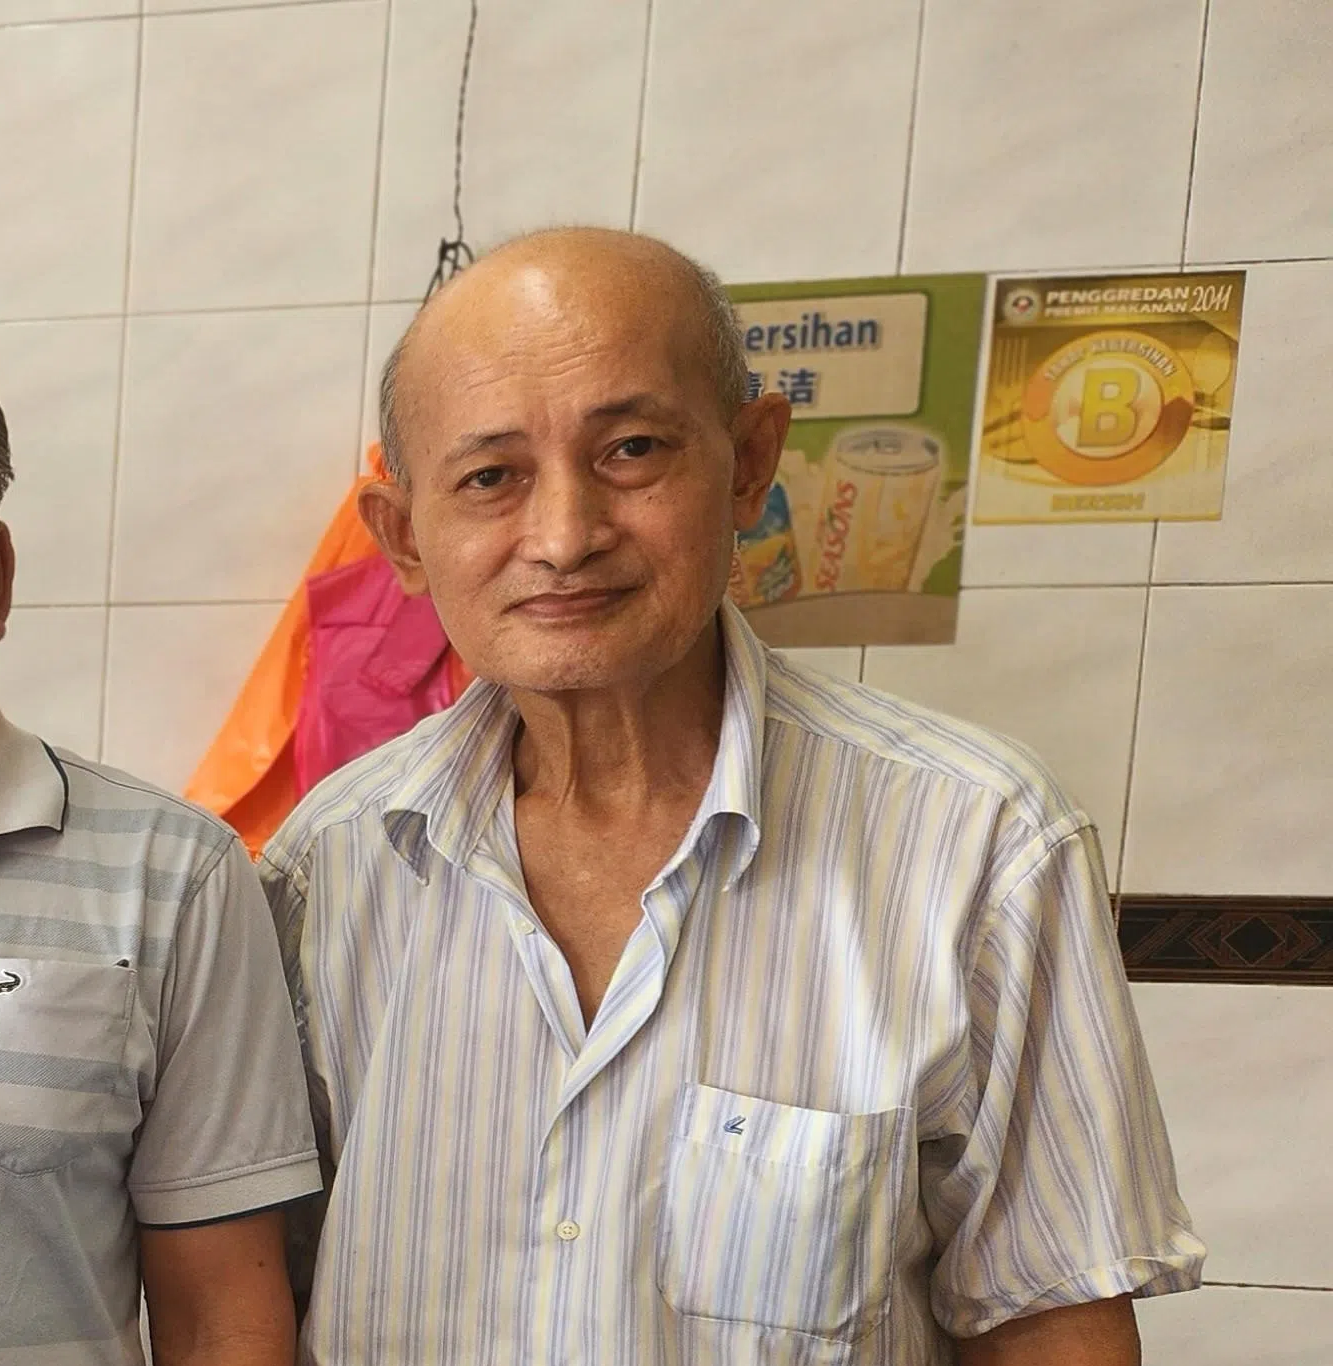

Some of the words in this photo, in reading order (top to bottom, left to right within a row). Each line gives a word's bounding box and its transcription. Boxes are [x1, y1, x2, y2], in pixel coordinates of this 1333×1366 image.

[1046, 286, 1189, 305] PENGGREDAN
[1104, 301, 1188, 314] MAKANAN
[745, 312, 879, 350] ersihan
[1075, 369, 1144, 447] B
[815, 480, 858, 590] SEASONS
